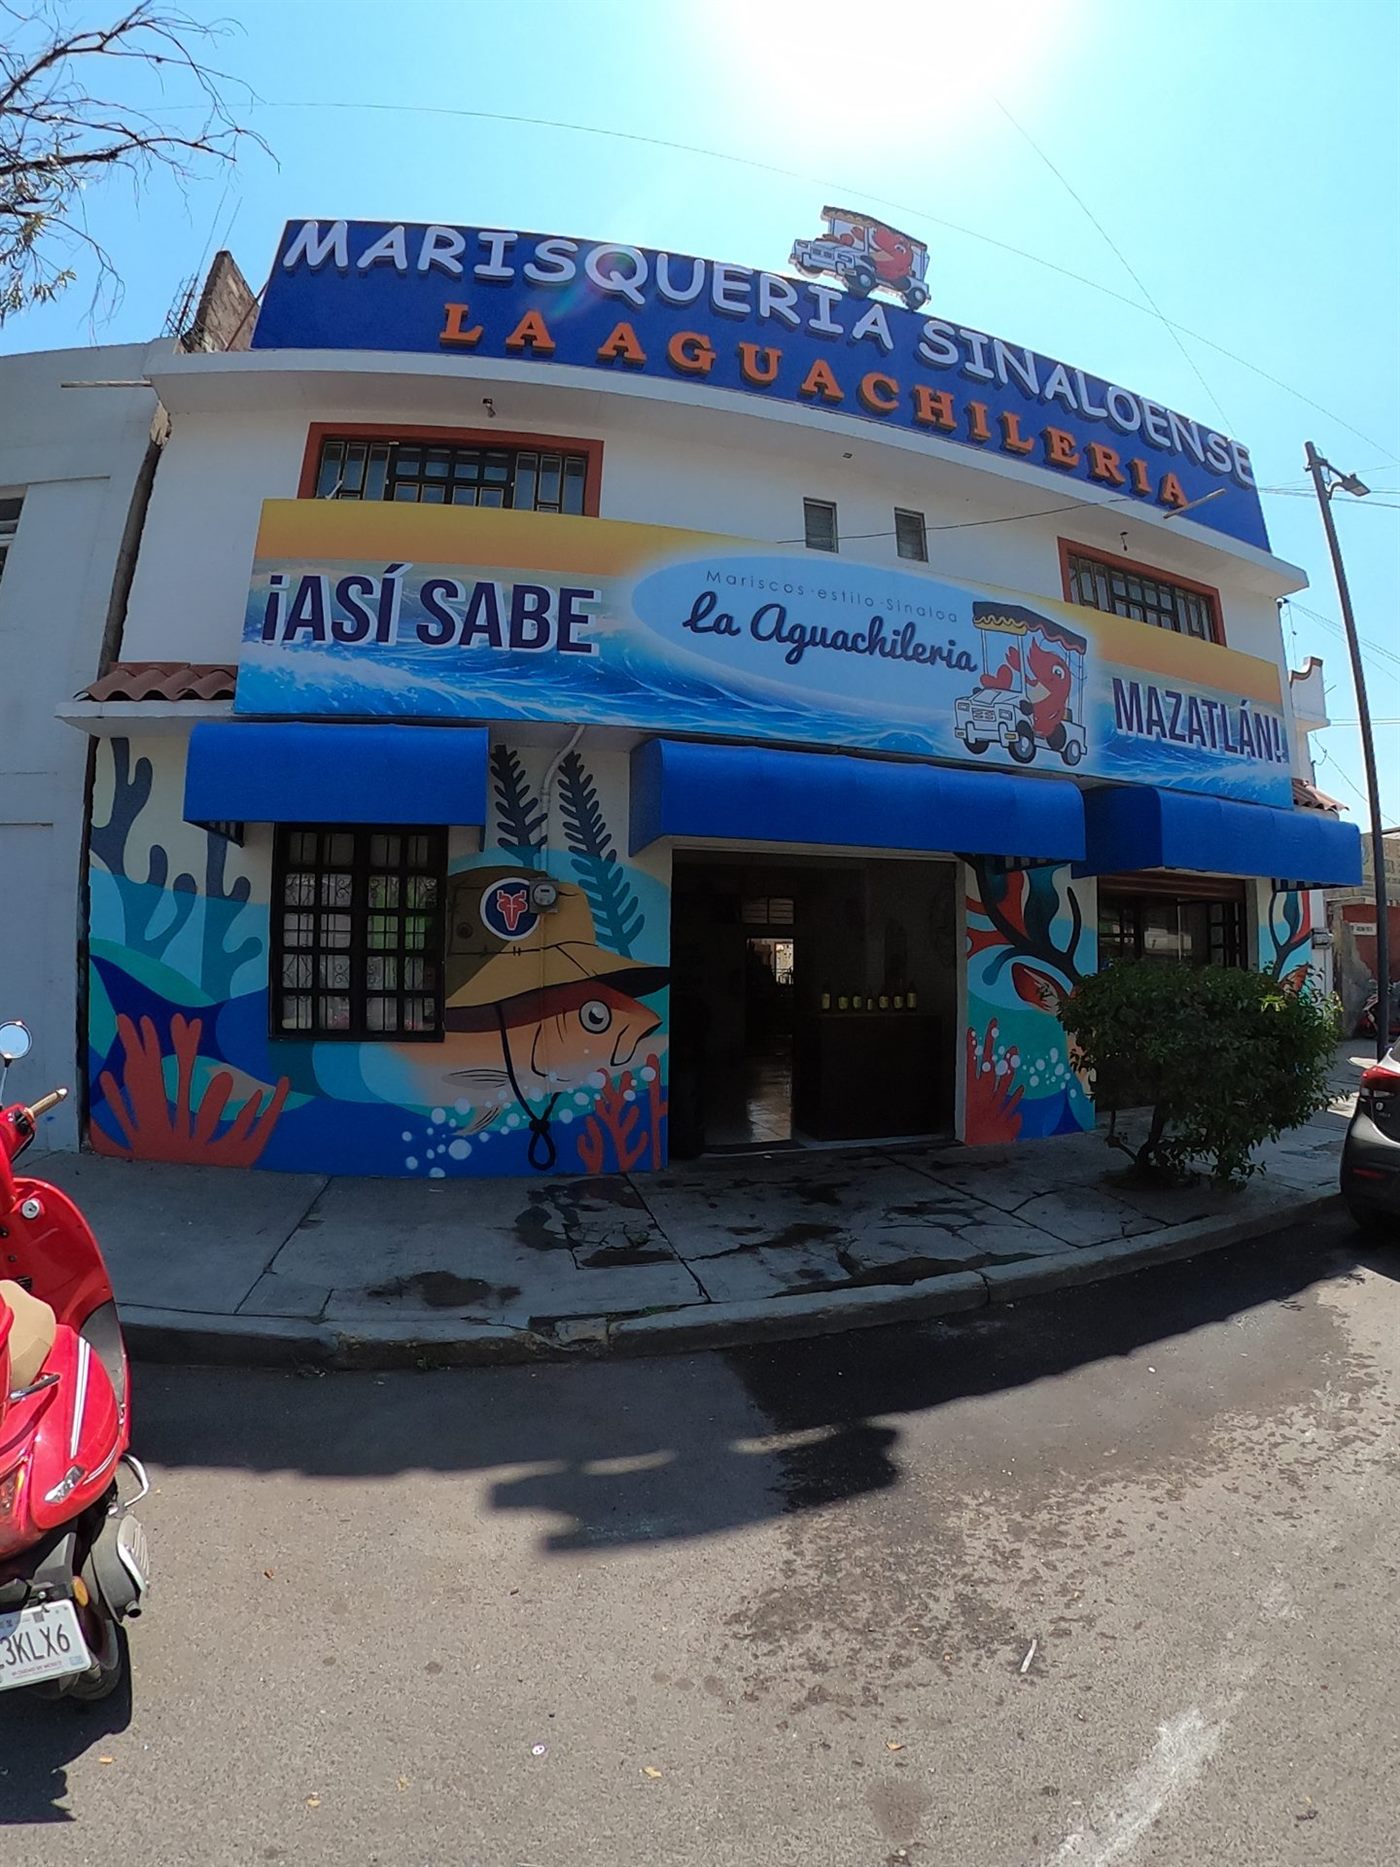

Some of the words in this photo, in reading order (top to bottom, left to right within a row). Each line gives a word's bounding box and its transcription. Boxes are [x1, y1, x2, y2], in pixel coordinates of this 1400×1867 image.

[283, 220, 894, 351] MARISQUERIA
[917, 320, 1256, 488] SINALOENSE
[438, 303, 556, 350] LA
[597, 322, 1188, 510] AGUACHILERIA
[416, 578, 597, 655] SABE
[706, 570, 804, 596] Mariscos
[817, 588, 875, 608] estilo
[885, 597, 959, 624] Sinaloa
[749, 602, 978, 673] Aguachileria
[1111, 676, 1286, 764] MAZATLÁN!
